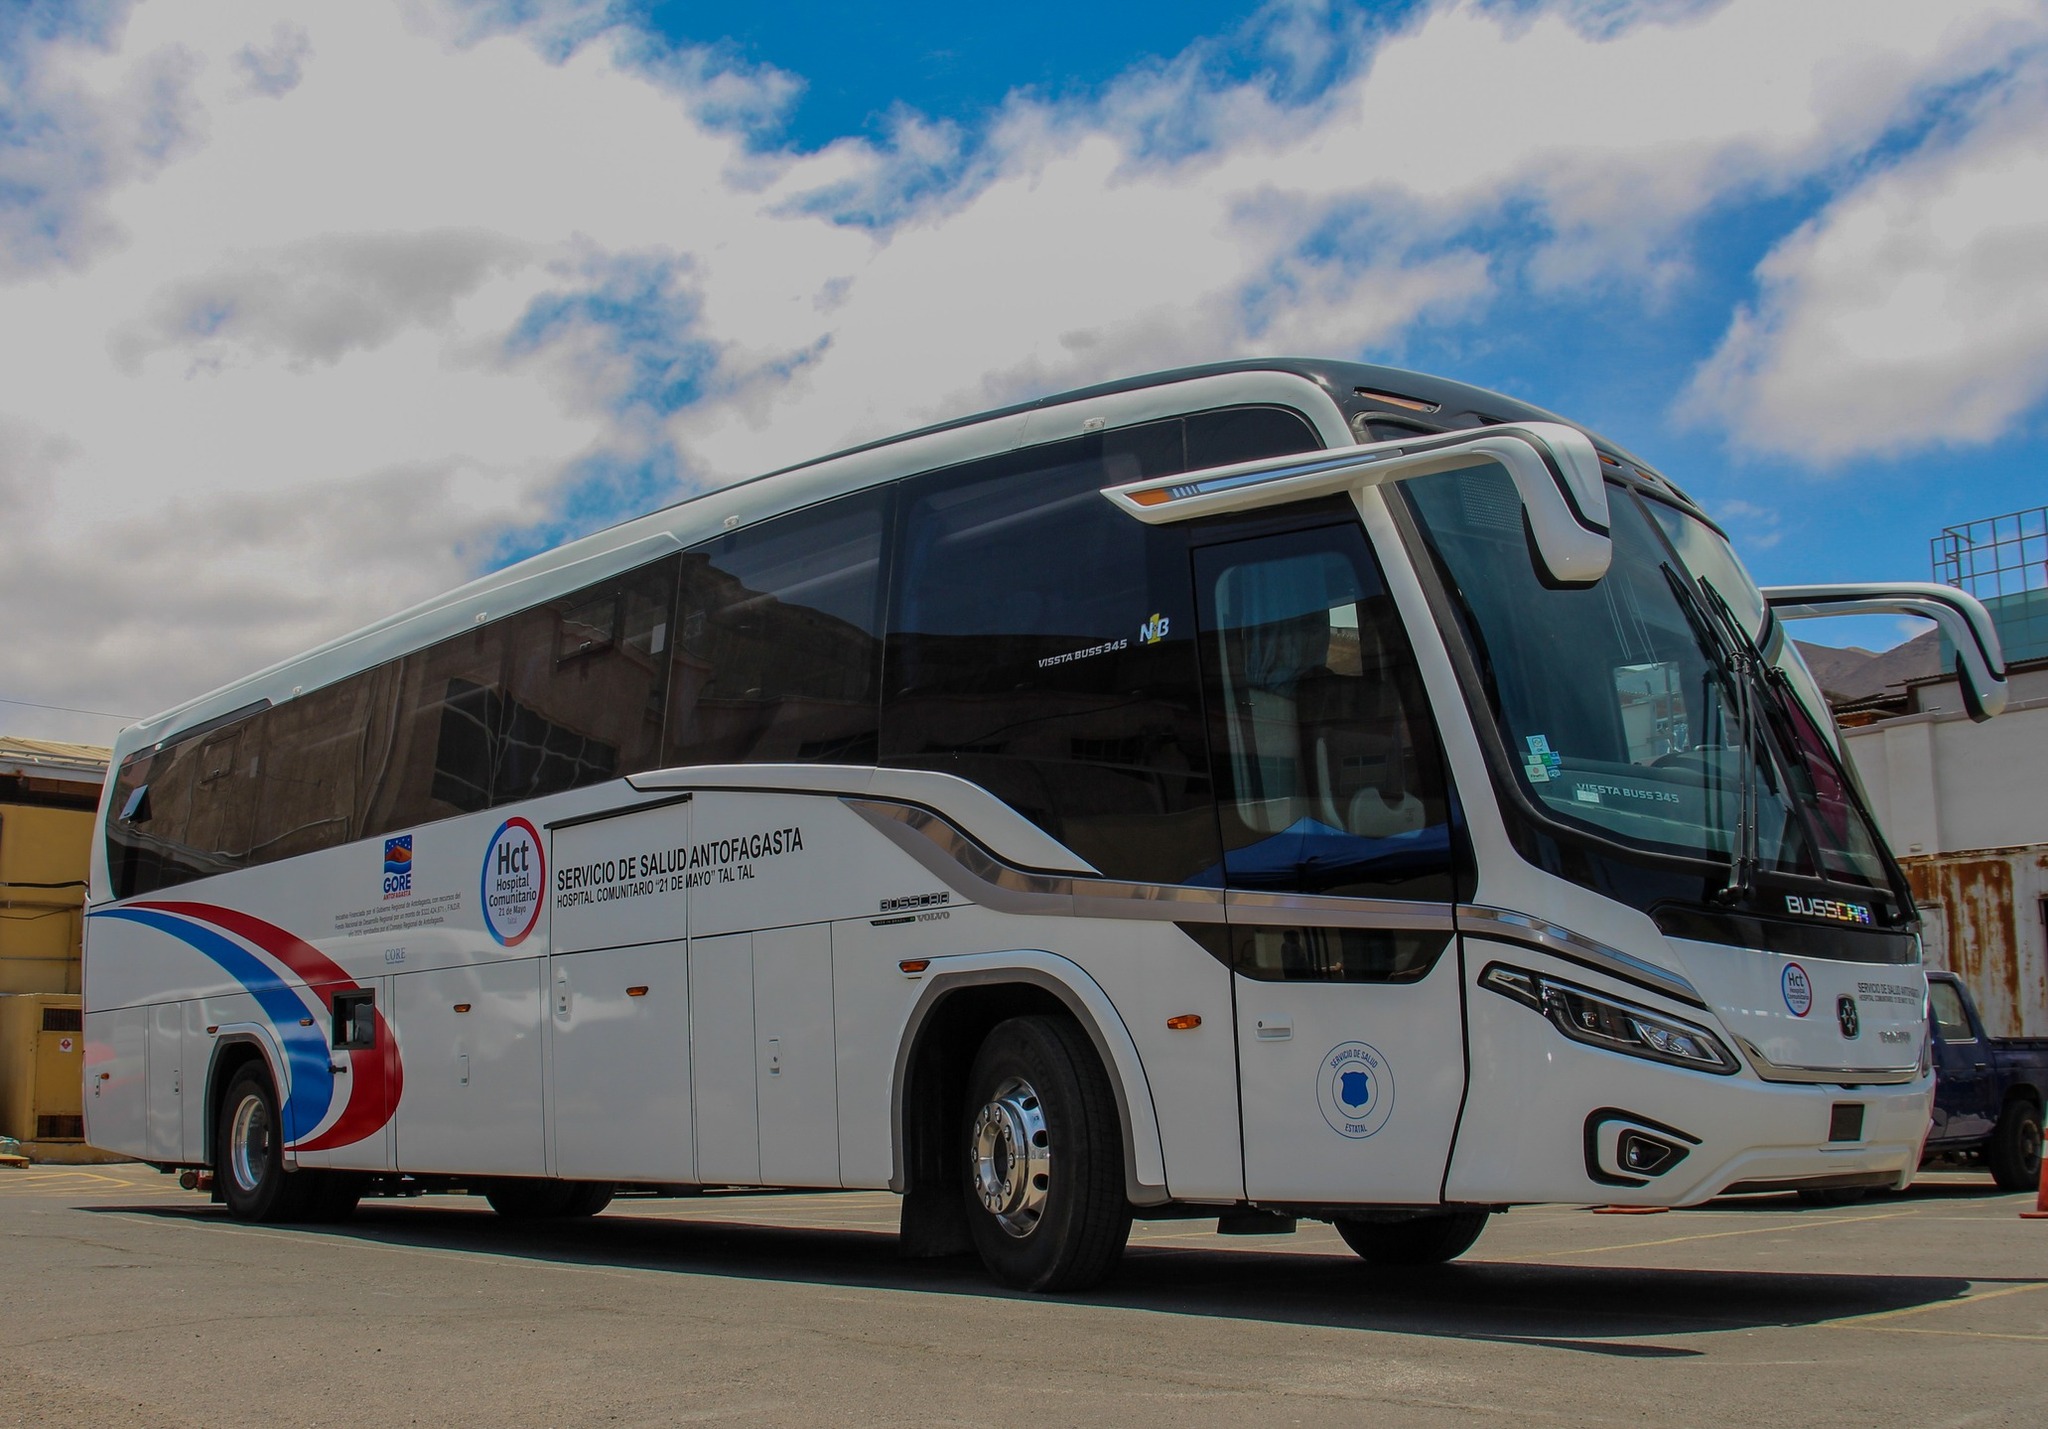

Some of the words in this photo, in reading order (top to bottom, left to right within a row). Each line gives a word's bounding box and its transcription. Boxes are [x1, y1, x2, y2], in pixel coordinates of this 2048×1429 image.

[1038, 654, 1073, 668] VISSTA
[1074, 645, 1102, 660] BUSS
[1104, 639, 1128, 652] 345
[1577, 783, 1620, 795] VISSTA
[1623, 788, 1653, 800] BUSS
[1655, 792, 1679, 803] 345
[498, 840, 529, 875] Hct
[558, 861, 614, 891] SERVICIO
[619, 857, 636, 880] DE
[640, 848, 686, 876] SALUD
[690, 827, 803, 868] ANTOFAGASTA
[384, 874, 411, 893] GORE
[497, 872, 529, 892] Hospital
[557, 890, 594, 908] HOSPITAL
[596, 881, 653, 902] COMUNITARIO
[672, 876, 683, 890] DE
[718, 868, 735, 884] TAL
[738, 864, 754, 879] TAL
[489, 887, 536, 907] Comunitario
[880, 892, 949, 912] BUSSCAR
[499, 907, 505, 916] 21
[506, 906, 512, 915] de
[513, 905, 526, 916] Mayo
[917, 911, 950, 922] VOLVO
[1785, 896, 1869, 924] BUSSCAR
[385, 947, 405, 960] CORE
[1788, 972, 1804, 987] Hct
[1858, 982, 1880, 993] SERVICIO
[1880, 984, 1887, 994] DE
[1888, 985, 1900, 995] SALUD
[1330, 1049, 1352, 1069] SERVICIO
[1354, 1049, 1360, 1057] DE
[1361, 1051, 1378, 1068] SALUD
[1345, 1123, 1367, 1133] ESTATAL
